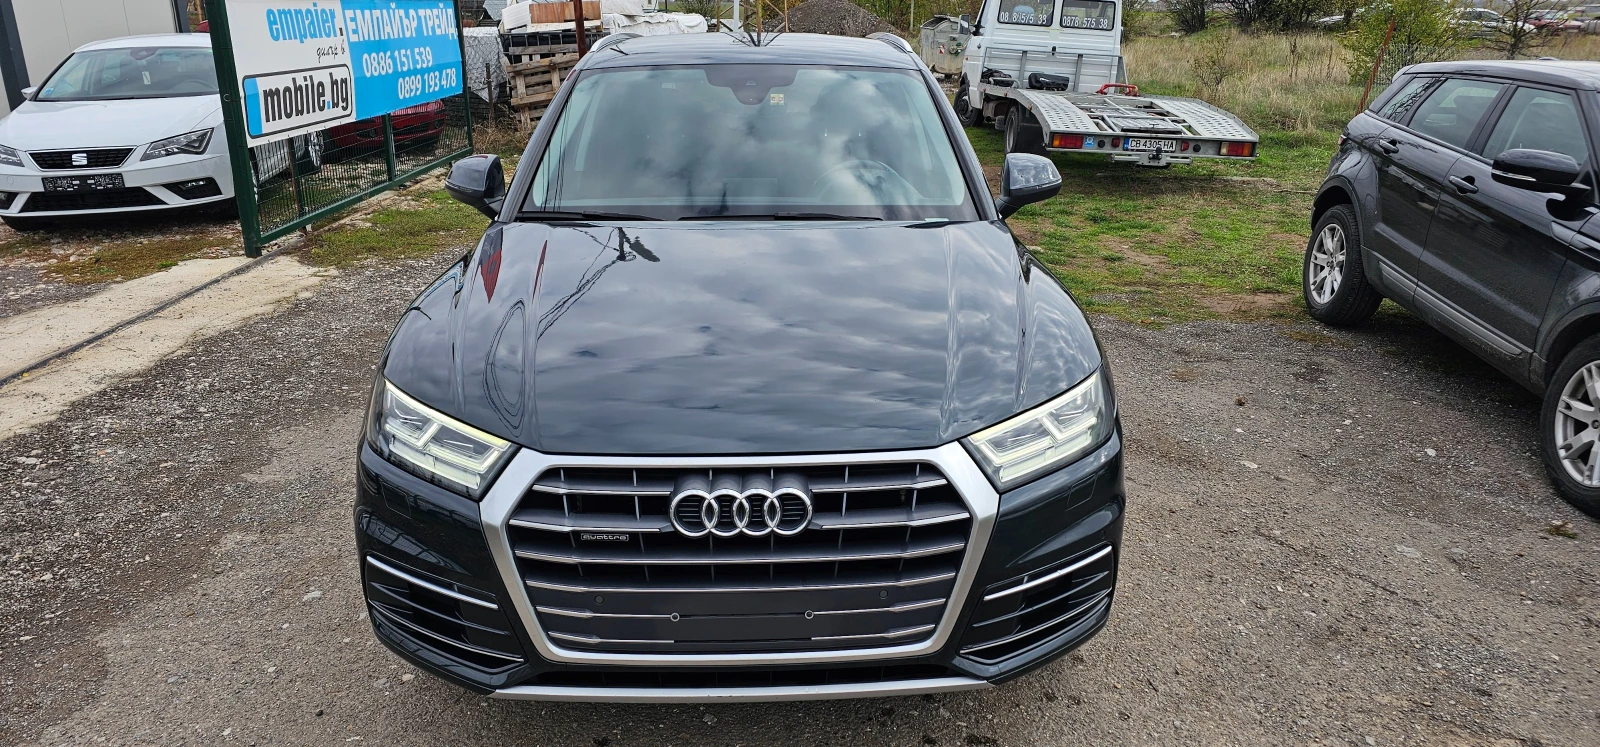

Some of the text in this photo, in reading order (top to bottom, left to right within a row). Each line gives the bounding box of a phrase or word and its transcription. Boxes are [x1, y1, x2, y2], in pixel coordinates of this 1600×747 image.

[345, 2, 457, 42] ЕМПАЙЪР ТРЕЙД
[1062, 16, 1079, 27] 0878
[1082, 17, 1096, 28] 575
[362, 46, 433, 78] 0886 151 539
[263, 72, 349, 123] mobile.bg
[398, 68, 456, 100] 0899 193 478
